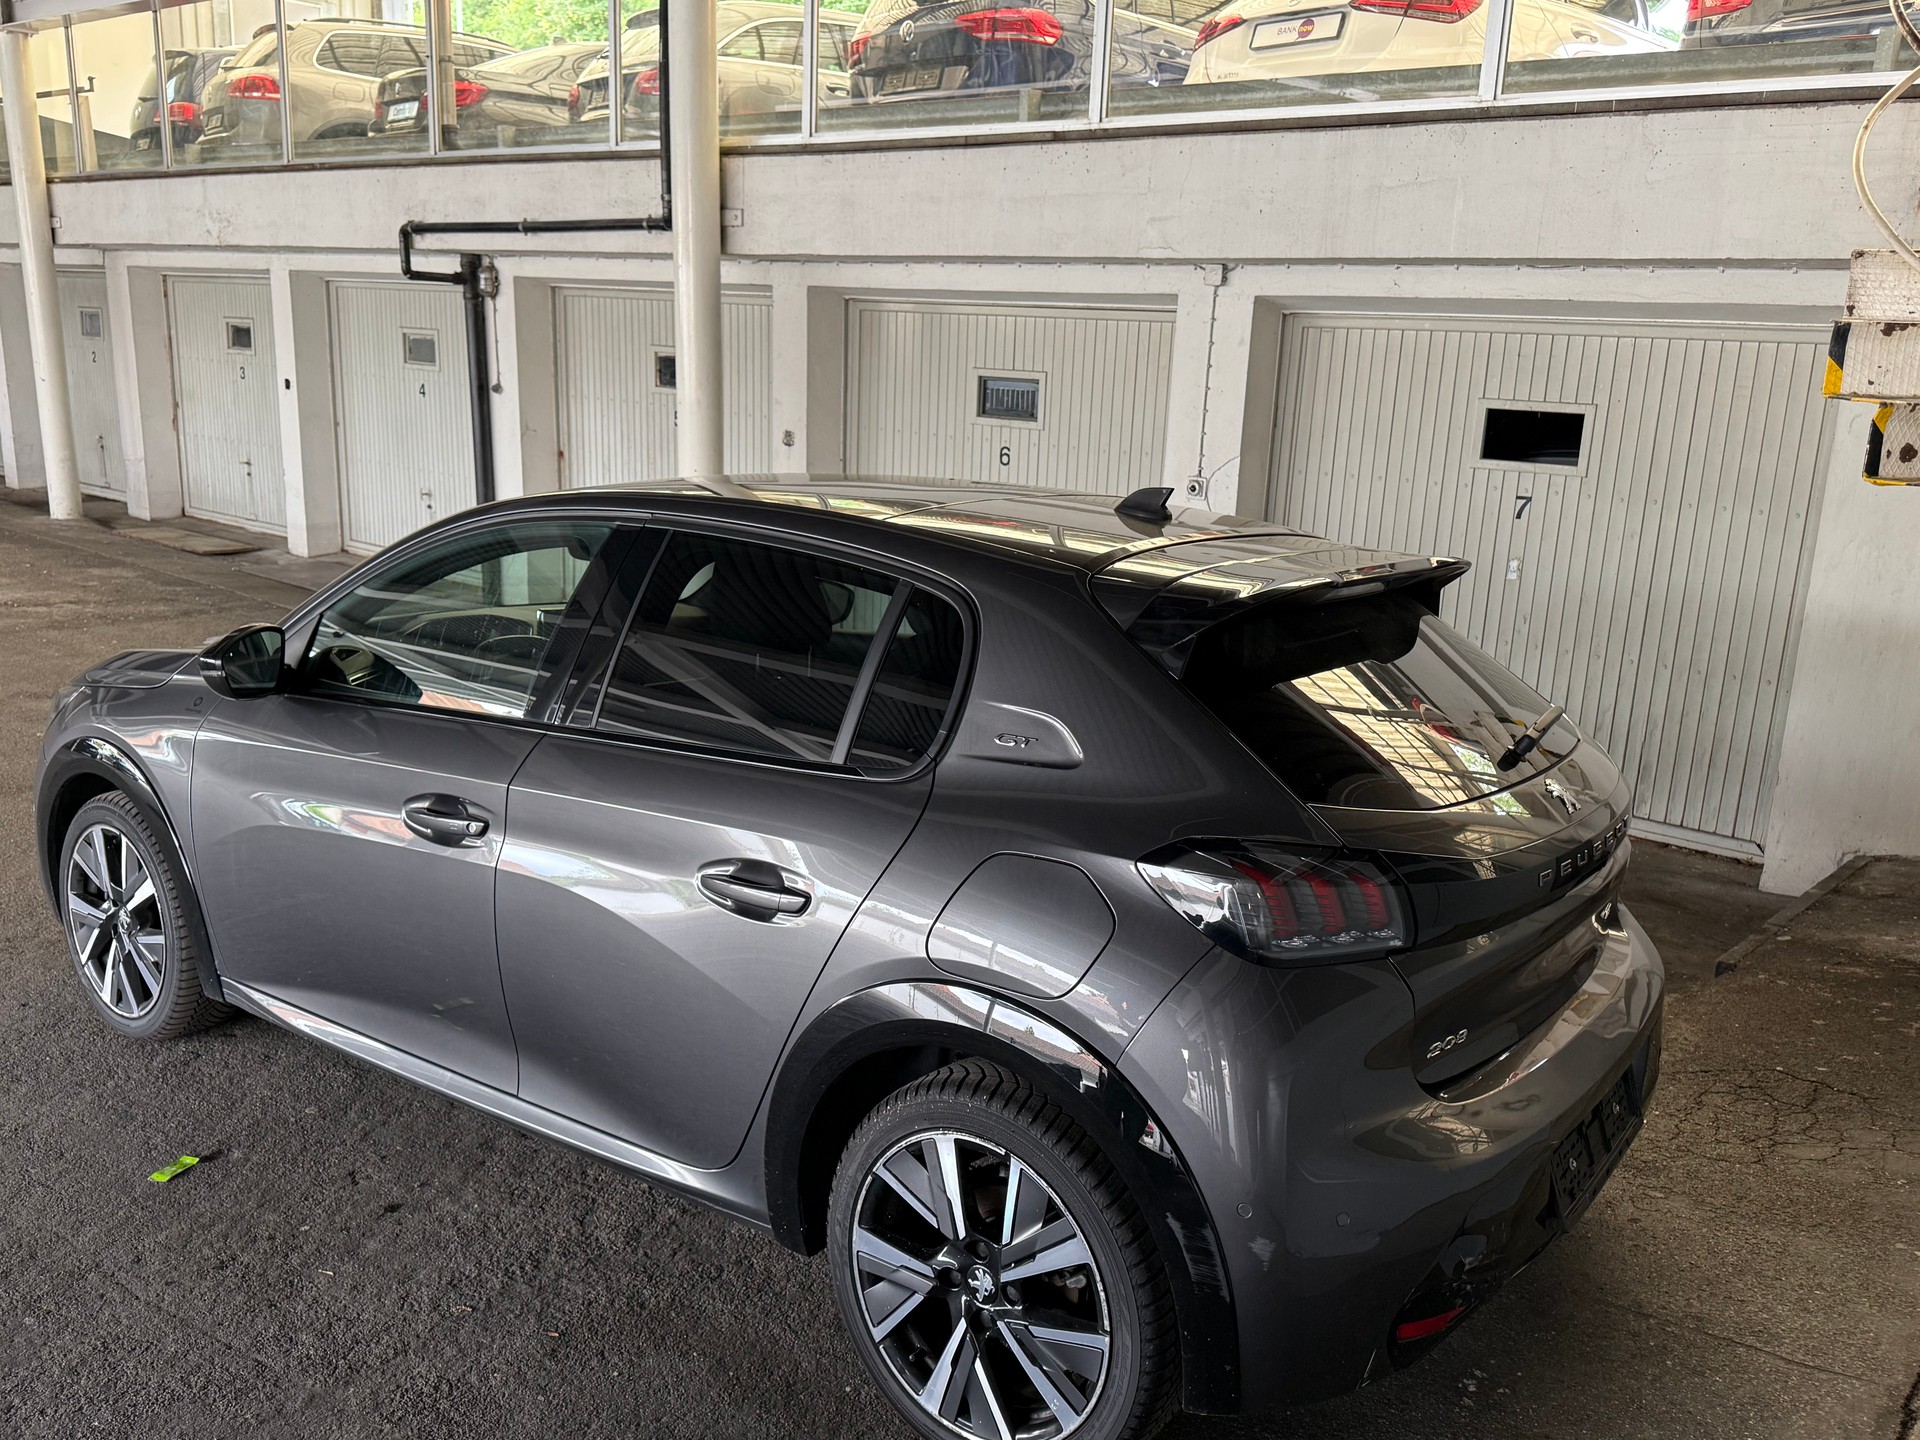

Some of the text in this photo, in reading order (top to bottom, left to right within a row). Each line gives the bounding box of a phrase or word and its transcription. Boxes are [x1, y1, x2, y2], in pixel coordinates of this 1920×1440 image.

[1277, 26, 1297, 35] BANK
[91, 351, 97, 363] 2
[239, 366, 246, 380] 3
[419, 383, 426, 398] 4
[999, 446, 1011, 467] 6
[1515, 495, 1533, 520] 7
[993, 732, 1039, 749] GT
[1426, 1028, 1468, 1059] 208
